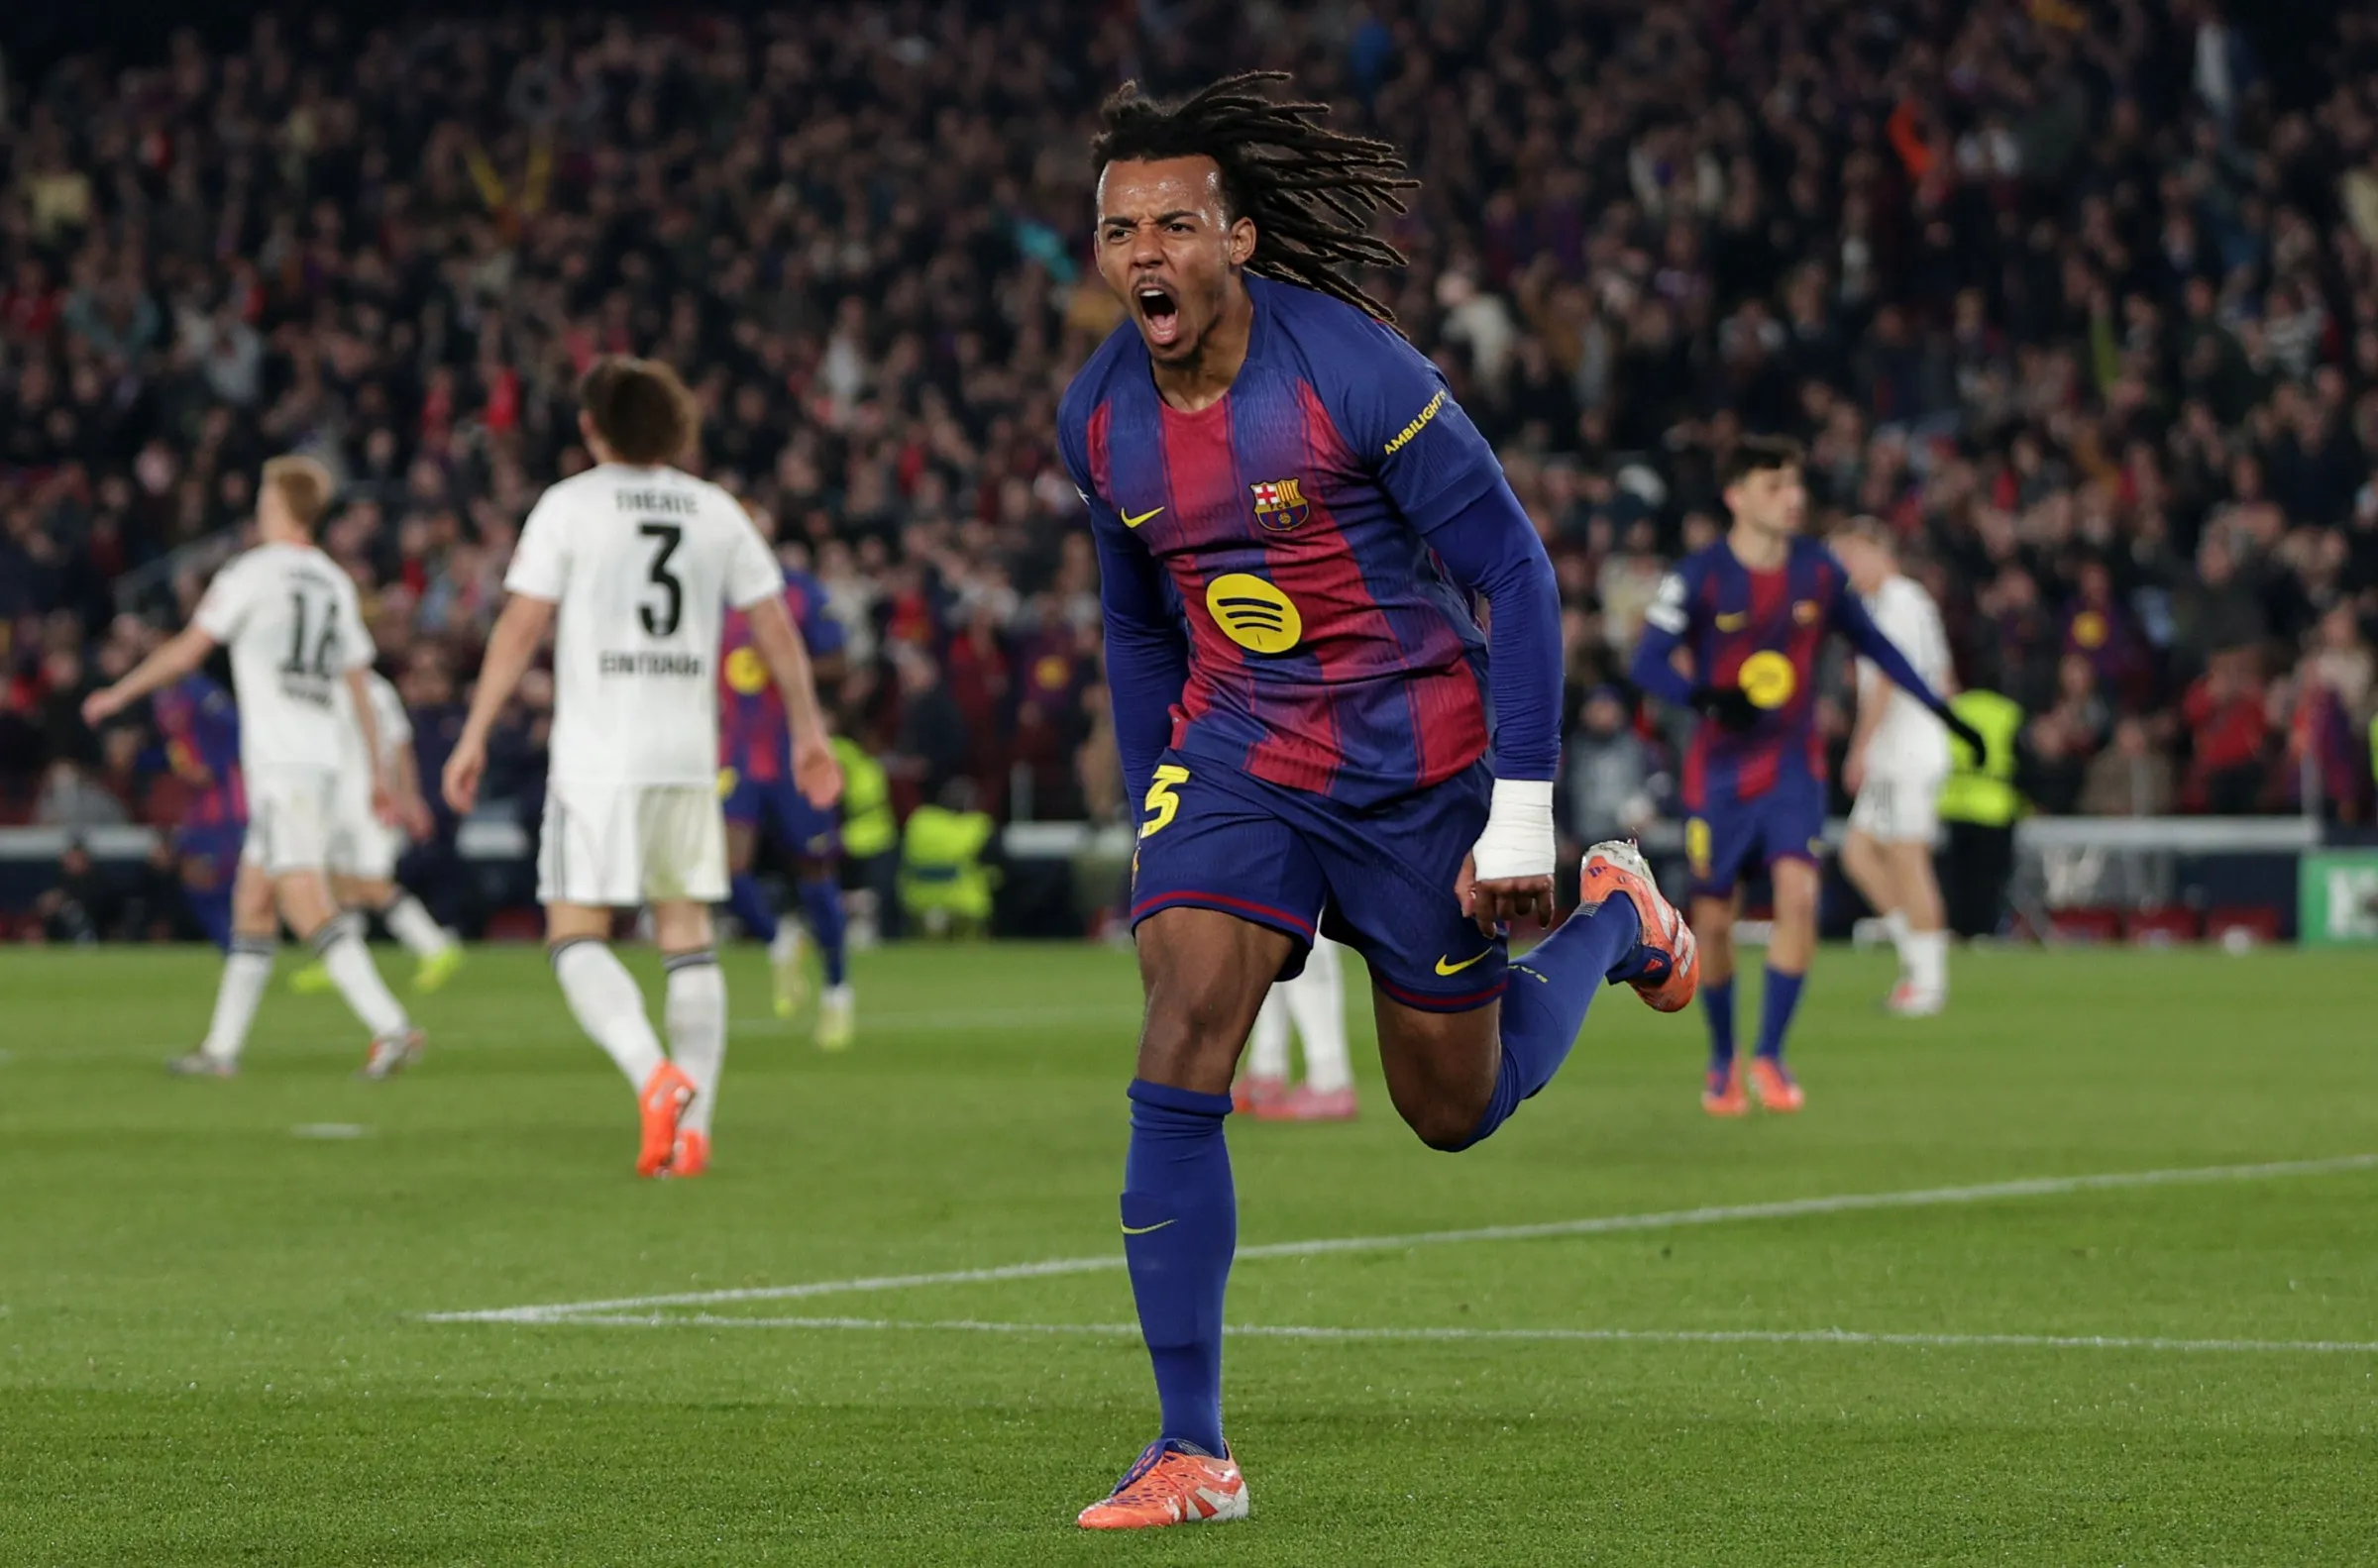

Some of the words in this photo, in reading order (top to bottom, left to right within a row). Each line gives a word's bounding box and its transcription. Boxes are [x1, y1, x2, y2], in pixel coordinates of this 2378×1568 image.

[1384, 393, 1442, 455] AMBILIGHT
[637, 523, 682, 636] 3
[279, 590, 344, 680] 16
